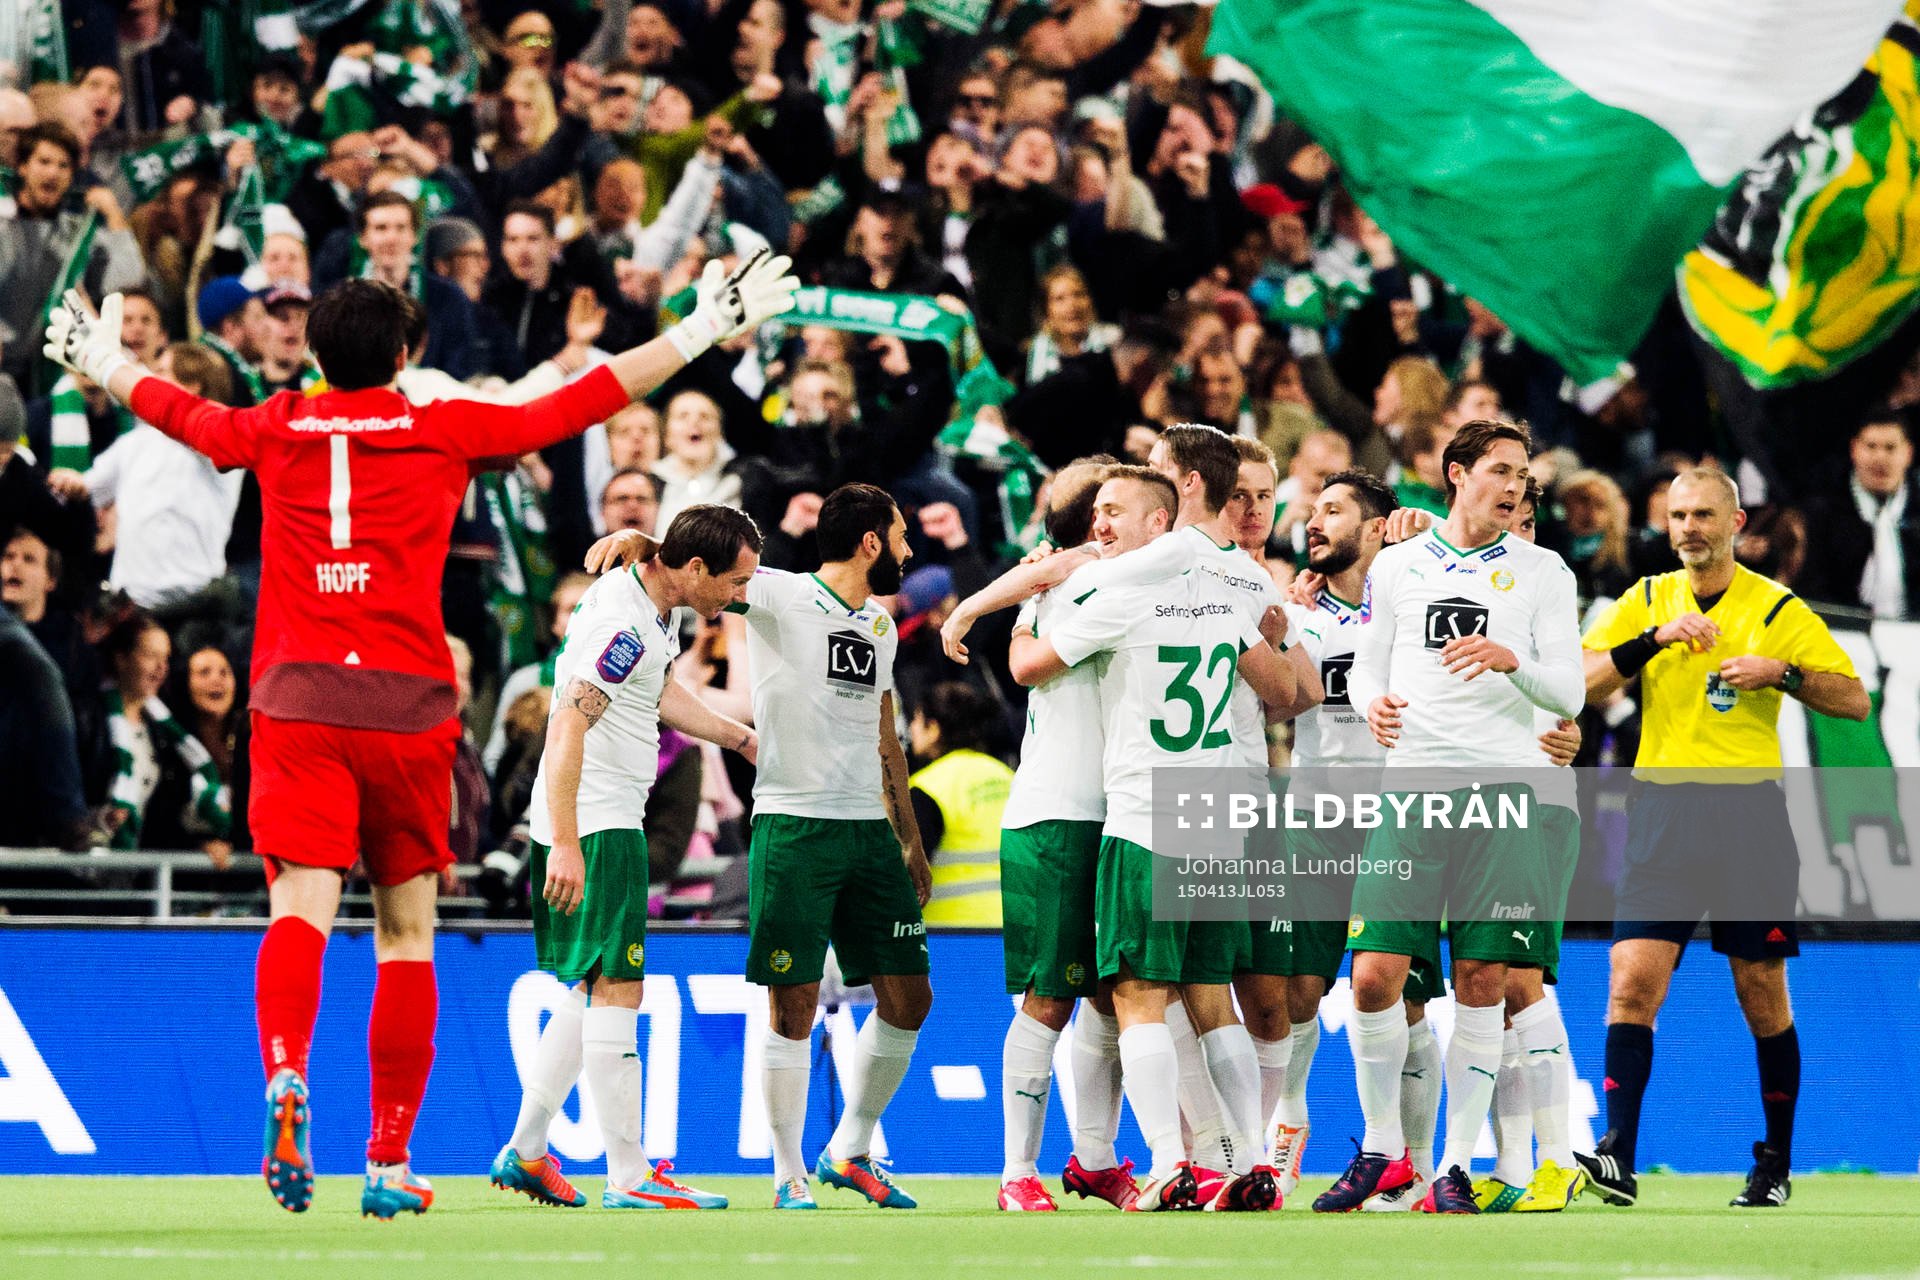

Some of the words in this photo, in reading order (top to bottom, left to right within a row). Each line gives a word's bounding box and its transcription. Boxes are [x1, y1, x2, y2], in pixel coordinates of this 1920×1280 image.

[329, 434, 351, 550] 1
[316, 562, 370, 593] HOPF
[832, 643, 873, 676] LW
[1150, 642, 1237, 752] 32
[1491, 901, 1535, 919] Inair
[893, 919, 926, 938] Inai
